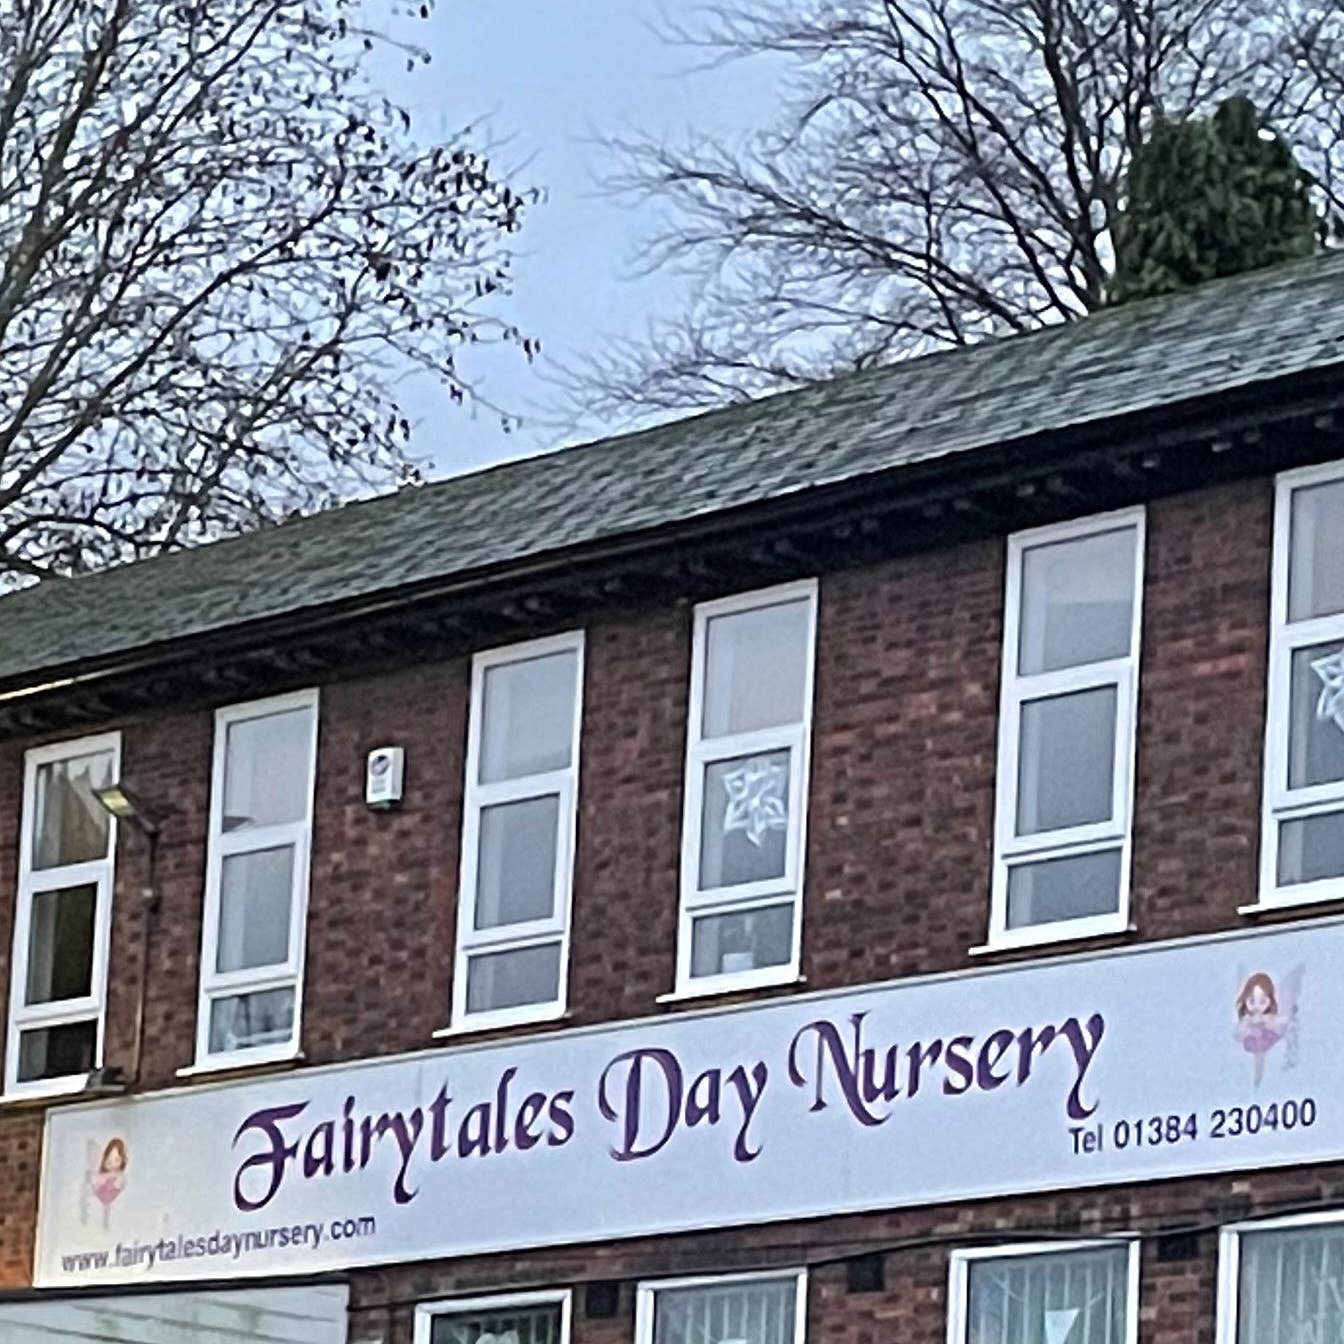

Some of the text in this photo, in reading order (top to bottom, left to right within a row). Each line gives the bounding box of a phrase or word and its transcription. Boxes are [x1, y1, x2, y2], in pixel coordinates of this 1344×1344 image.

[232, 1010, 1105, 1212] Fairytales Day Nursery
[1068, 1097, 1317, 1155] Tel 01384 230400
[61, 1215, 376, 1274] www.fairytalesdaynursery.com
